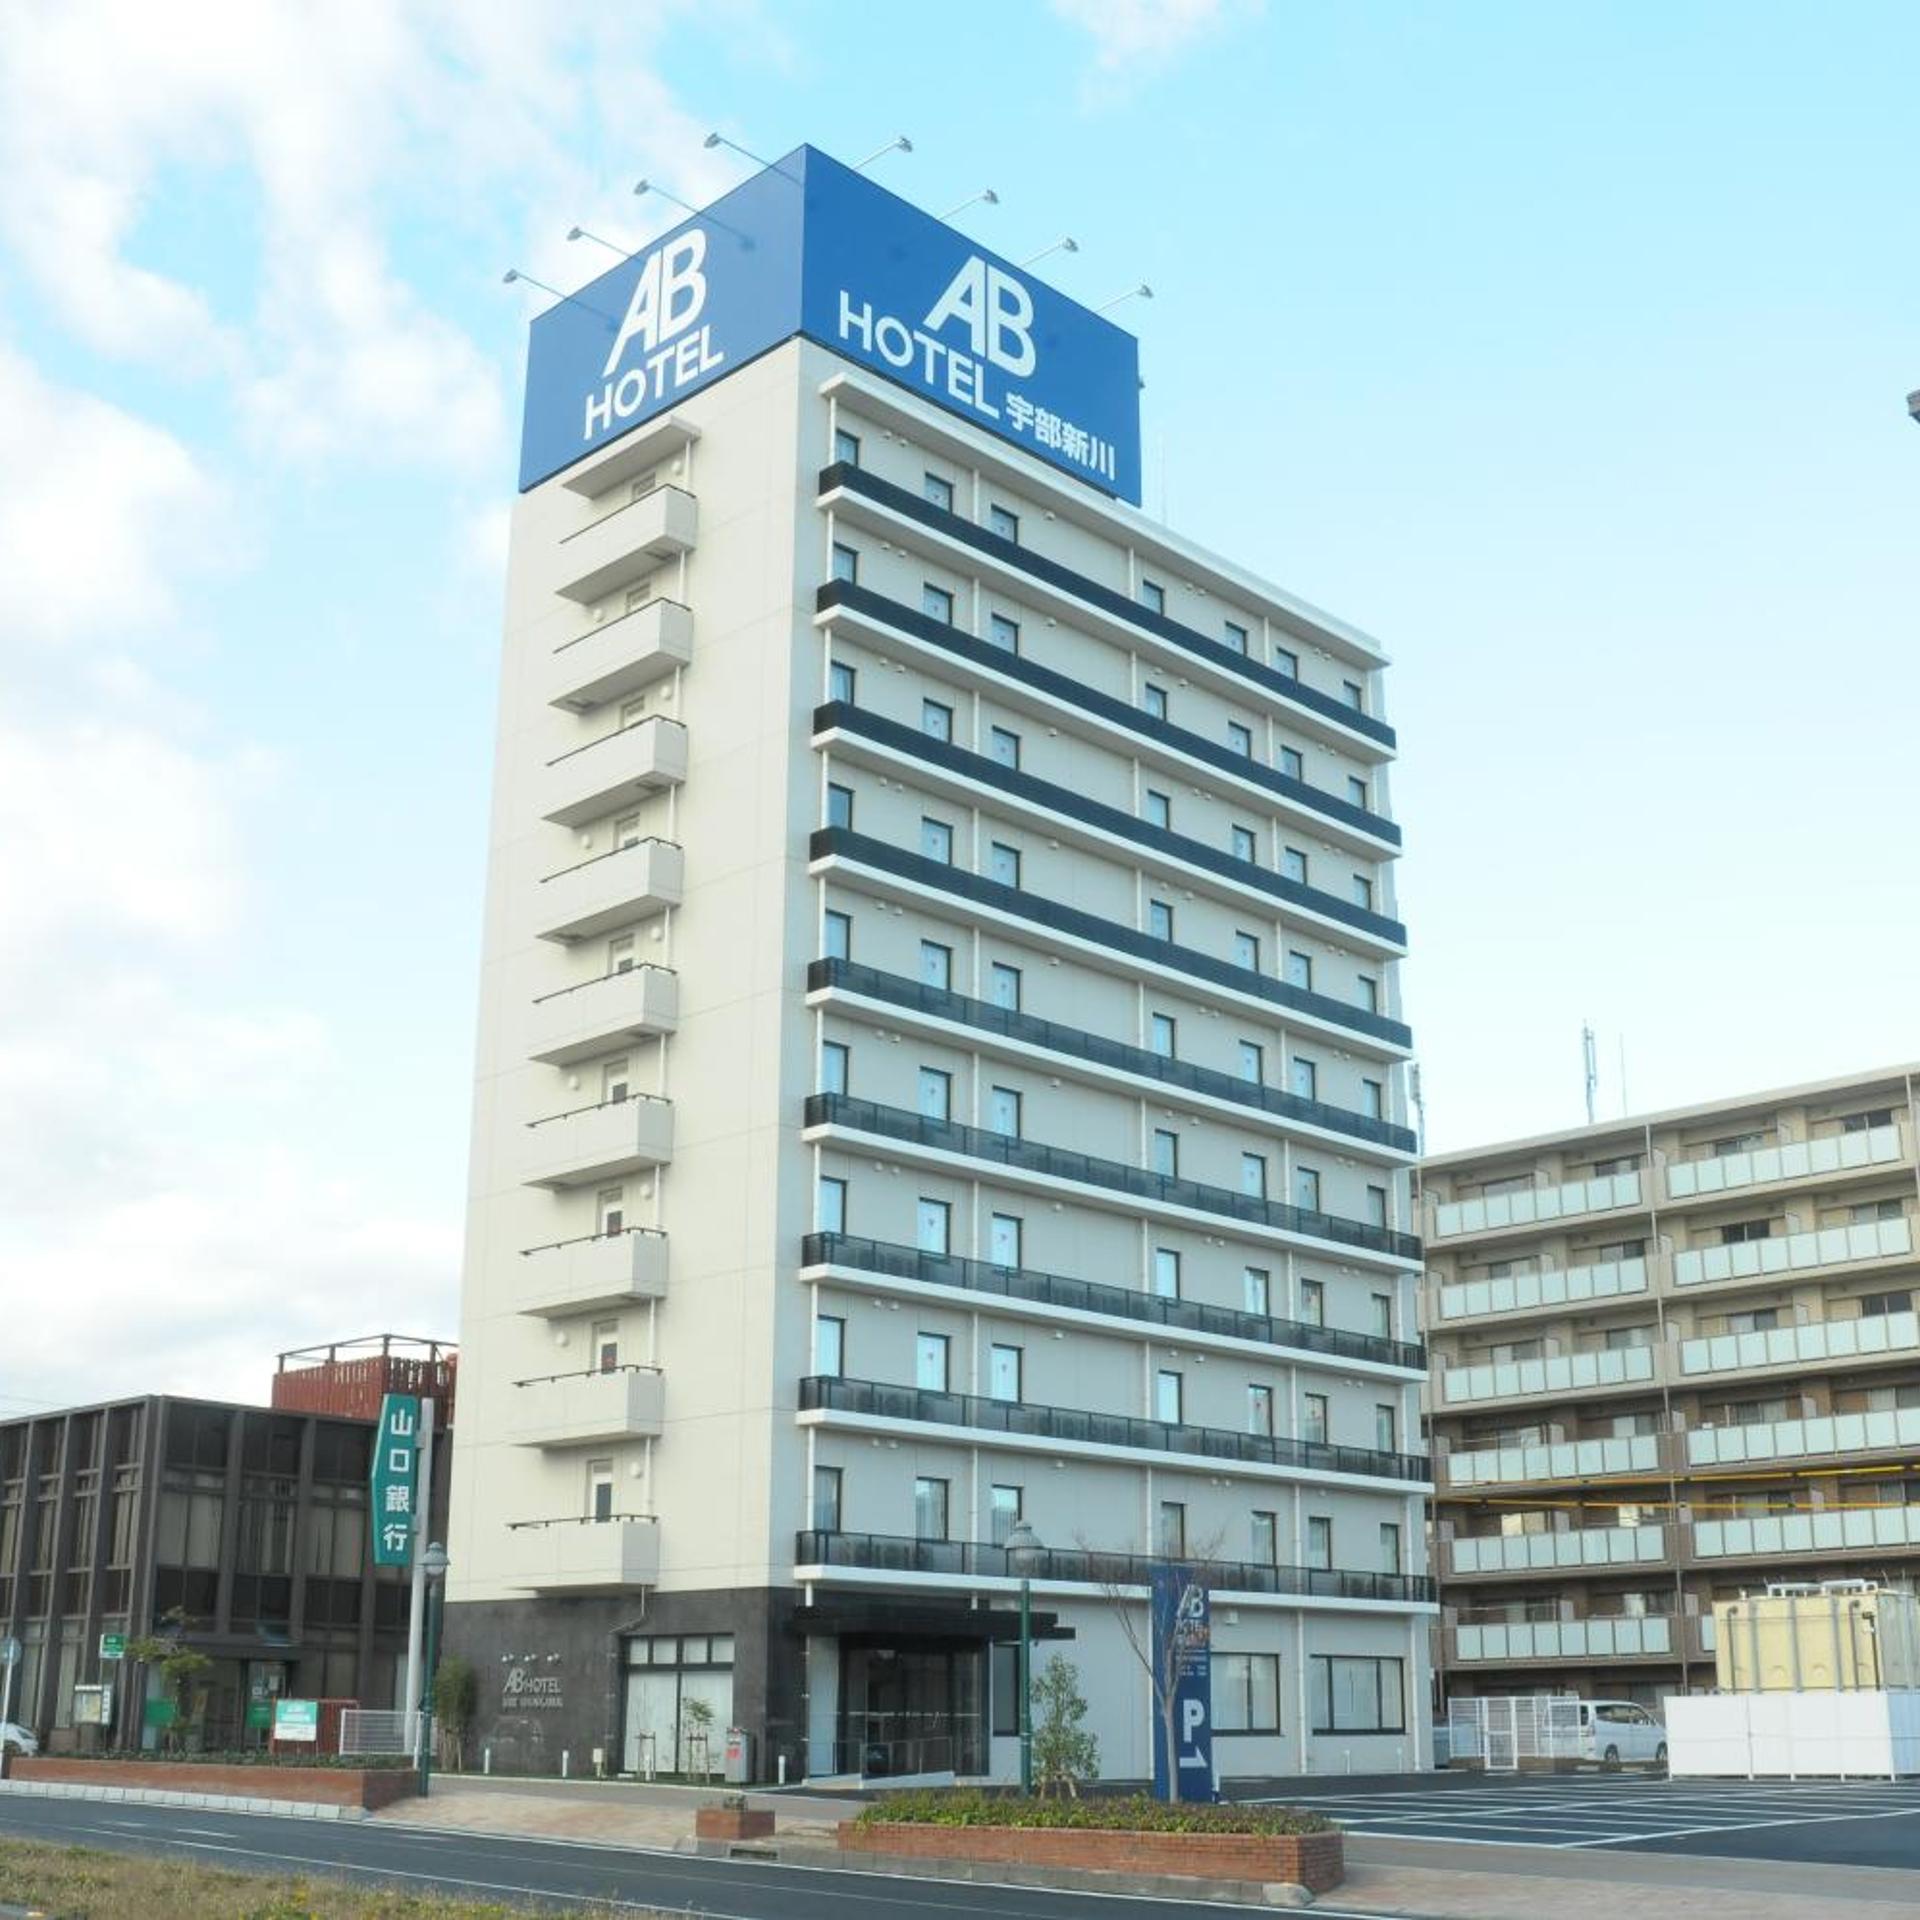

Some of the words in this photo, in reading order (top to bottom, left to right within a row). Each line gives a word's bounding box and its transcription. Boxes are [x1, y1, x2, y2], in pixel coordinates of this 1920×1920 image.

[602, 228, 707, 378] AB
[923, 255, 1036, 377] AB
[583, 324, 724, 440] HOTEL
[839, 290, 1000, 419] HOTEL
[1005, 392, 1115, 481] 宇部新川
[383, 1408, 413, 1551] 山口銀行
[502, 1667, 524, 1694] AB
[525, 1677, 561, 1694] HOTEL
[1183, 1699, 1204, 1743] P
